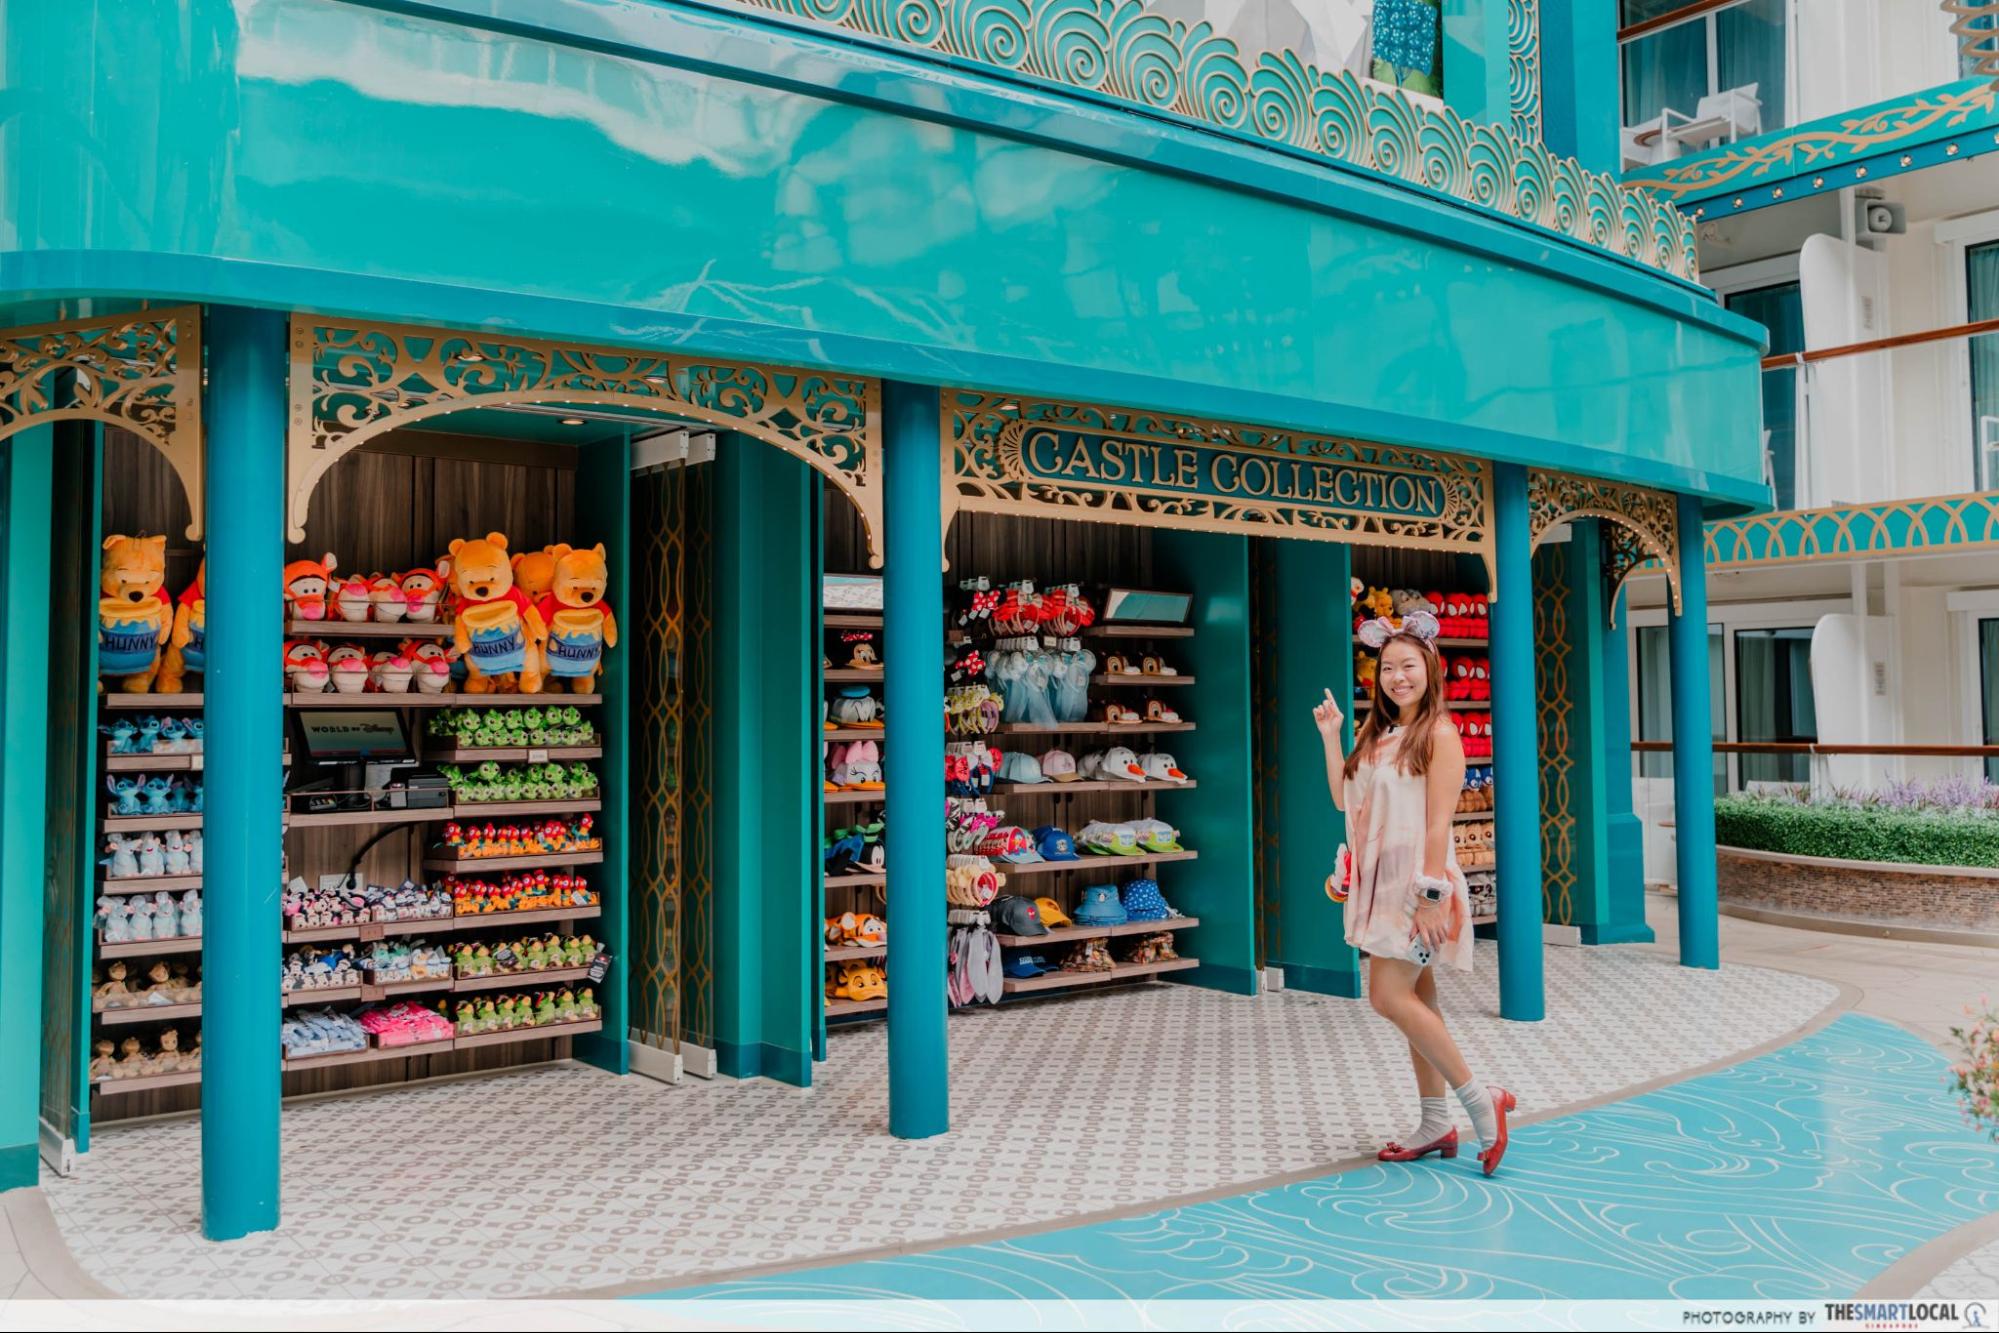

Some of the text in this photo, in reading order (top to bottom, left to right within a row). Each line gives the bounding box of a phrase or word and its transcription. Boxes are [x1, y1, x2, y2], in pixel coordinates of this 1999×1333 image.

[1029, 431, 1438, 514] CASTLE COLLECTION
[473, 635, 515, 655] HUNNY
